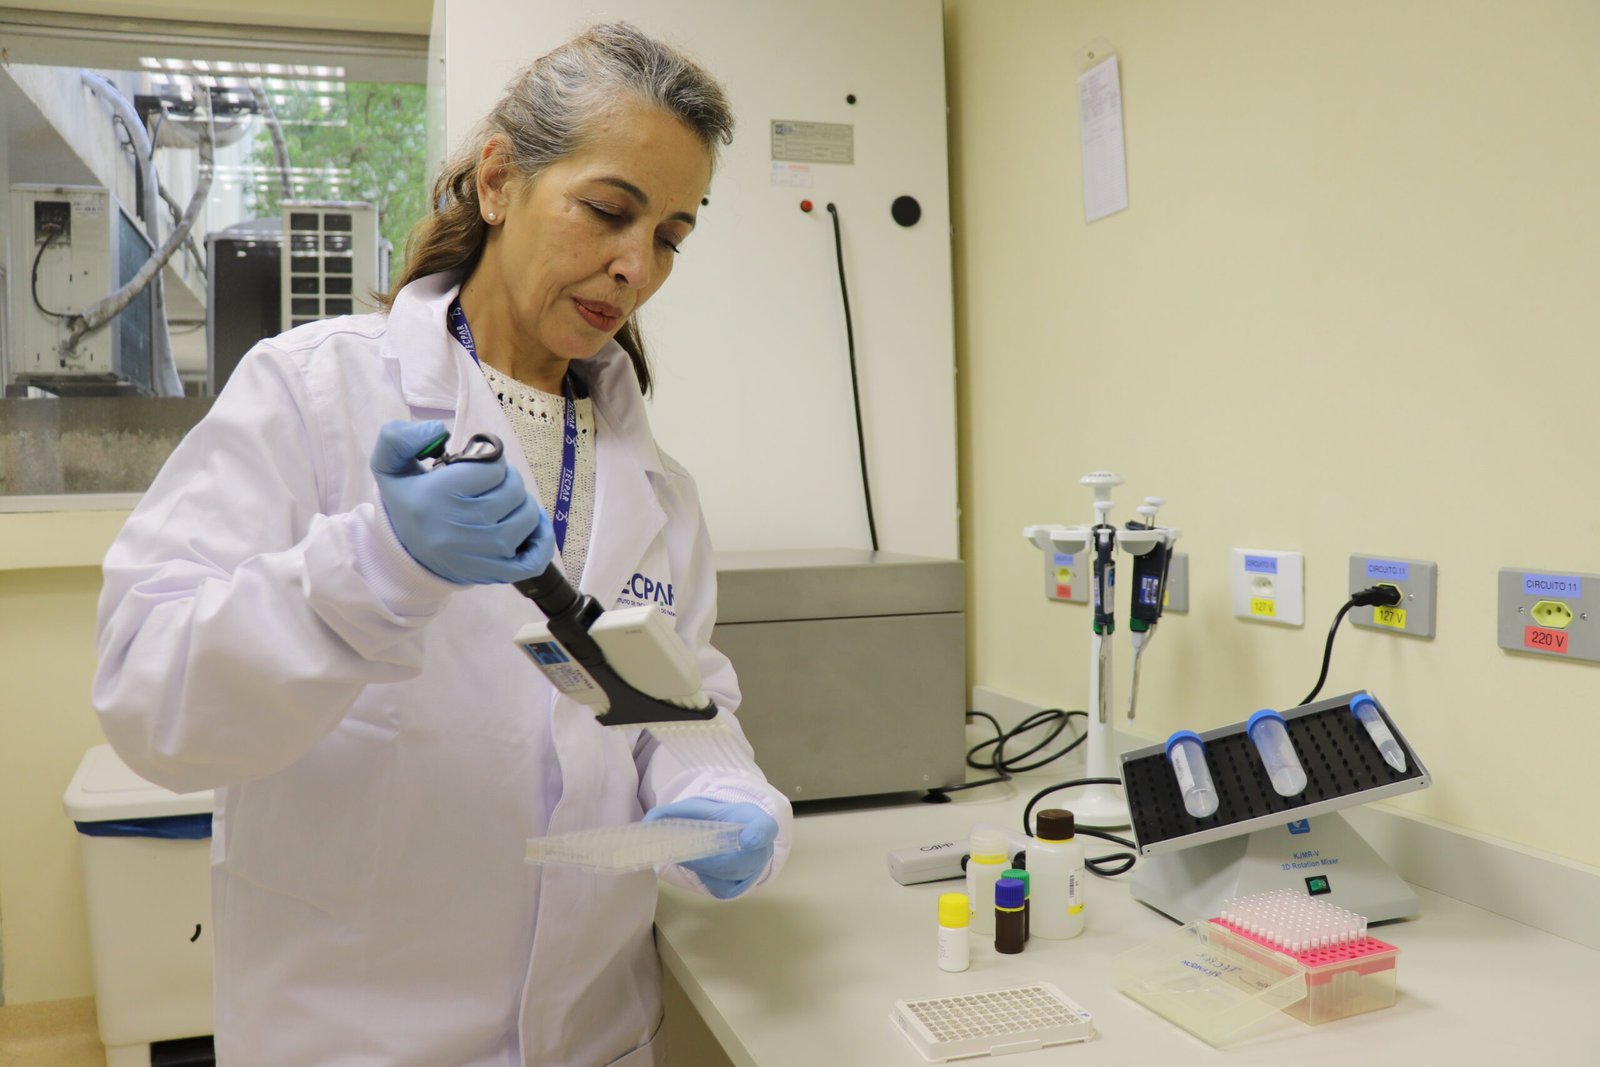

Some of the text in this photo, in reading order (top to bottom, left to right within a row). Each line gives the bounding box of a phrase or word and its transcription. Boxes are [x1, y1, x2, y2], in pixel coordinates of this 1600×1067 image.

[563, 468, 574, 502] TECPAR
[1368, 564, 1406, 575] CIRCUITO 11
[1526, 579, 1577, 592] CIRCUITO 11
[1380, 609, 1404, 624] 127 V
[1531, 630, 1565, 648] 220 V
[1292, 860, 1321, 870] Rotation
